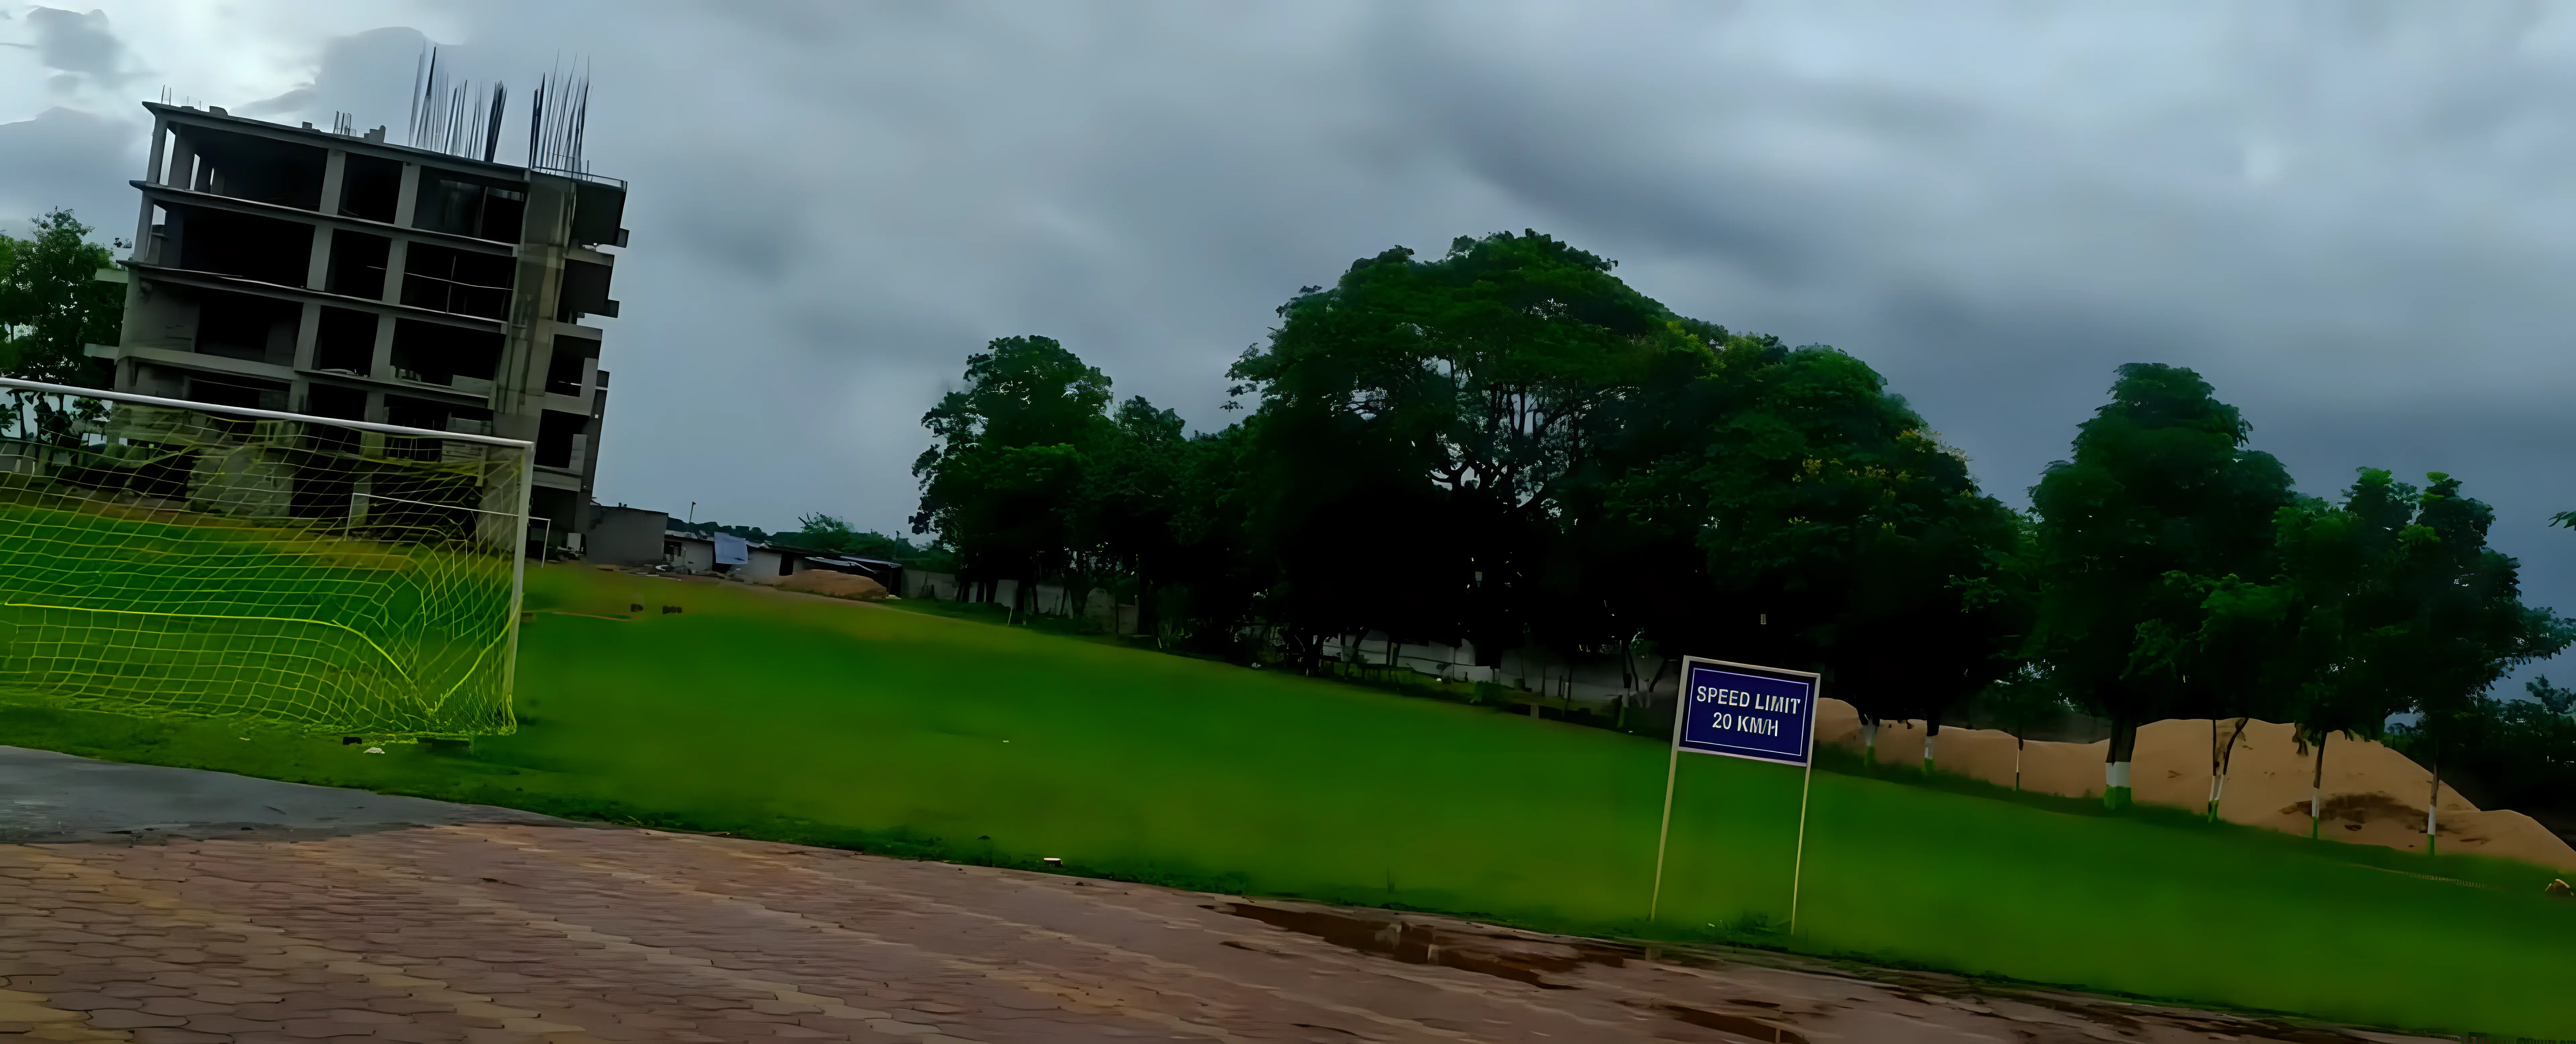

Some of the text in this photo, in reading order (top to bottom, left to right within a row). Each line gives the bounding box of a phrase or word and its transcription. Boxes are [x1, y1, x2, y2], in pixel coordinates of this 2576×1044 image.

[1697, 686, 1800, 714] SPEED LIMIT
[1713, 712, 1778, 736] 20 KM/H
